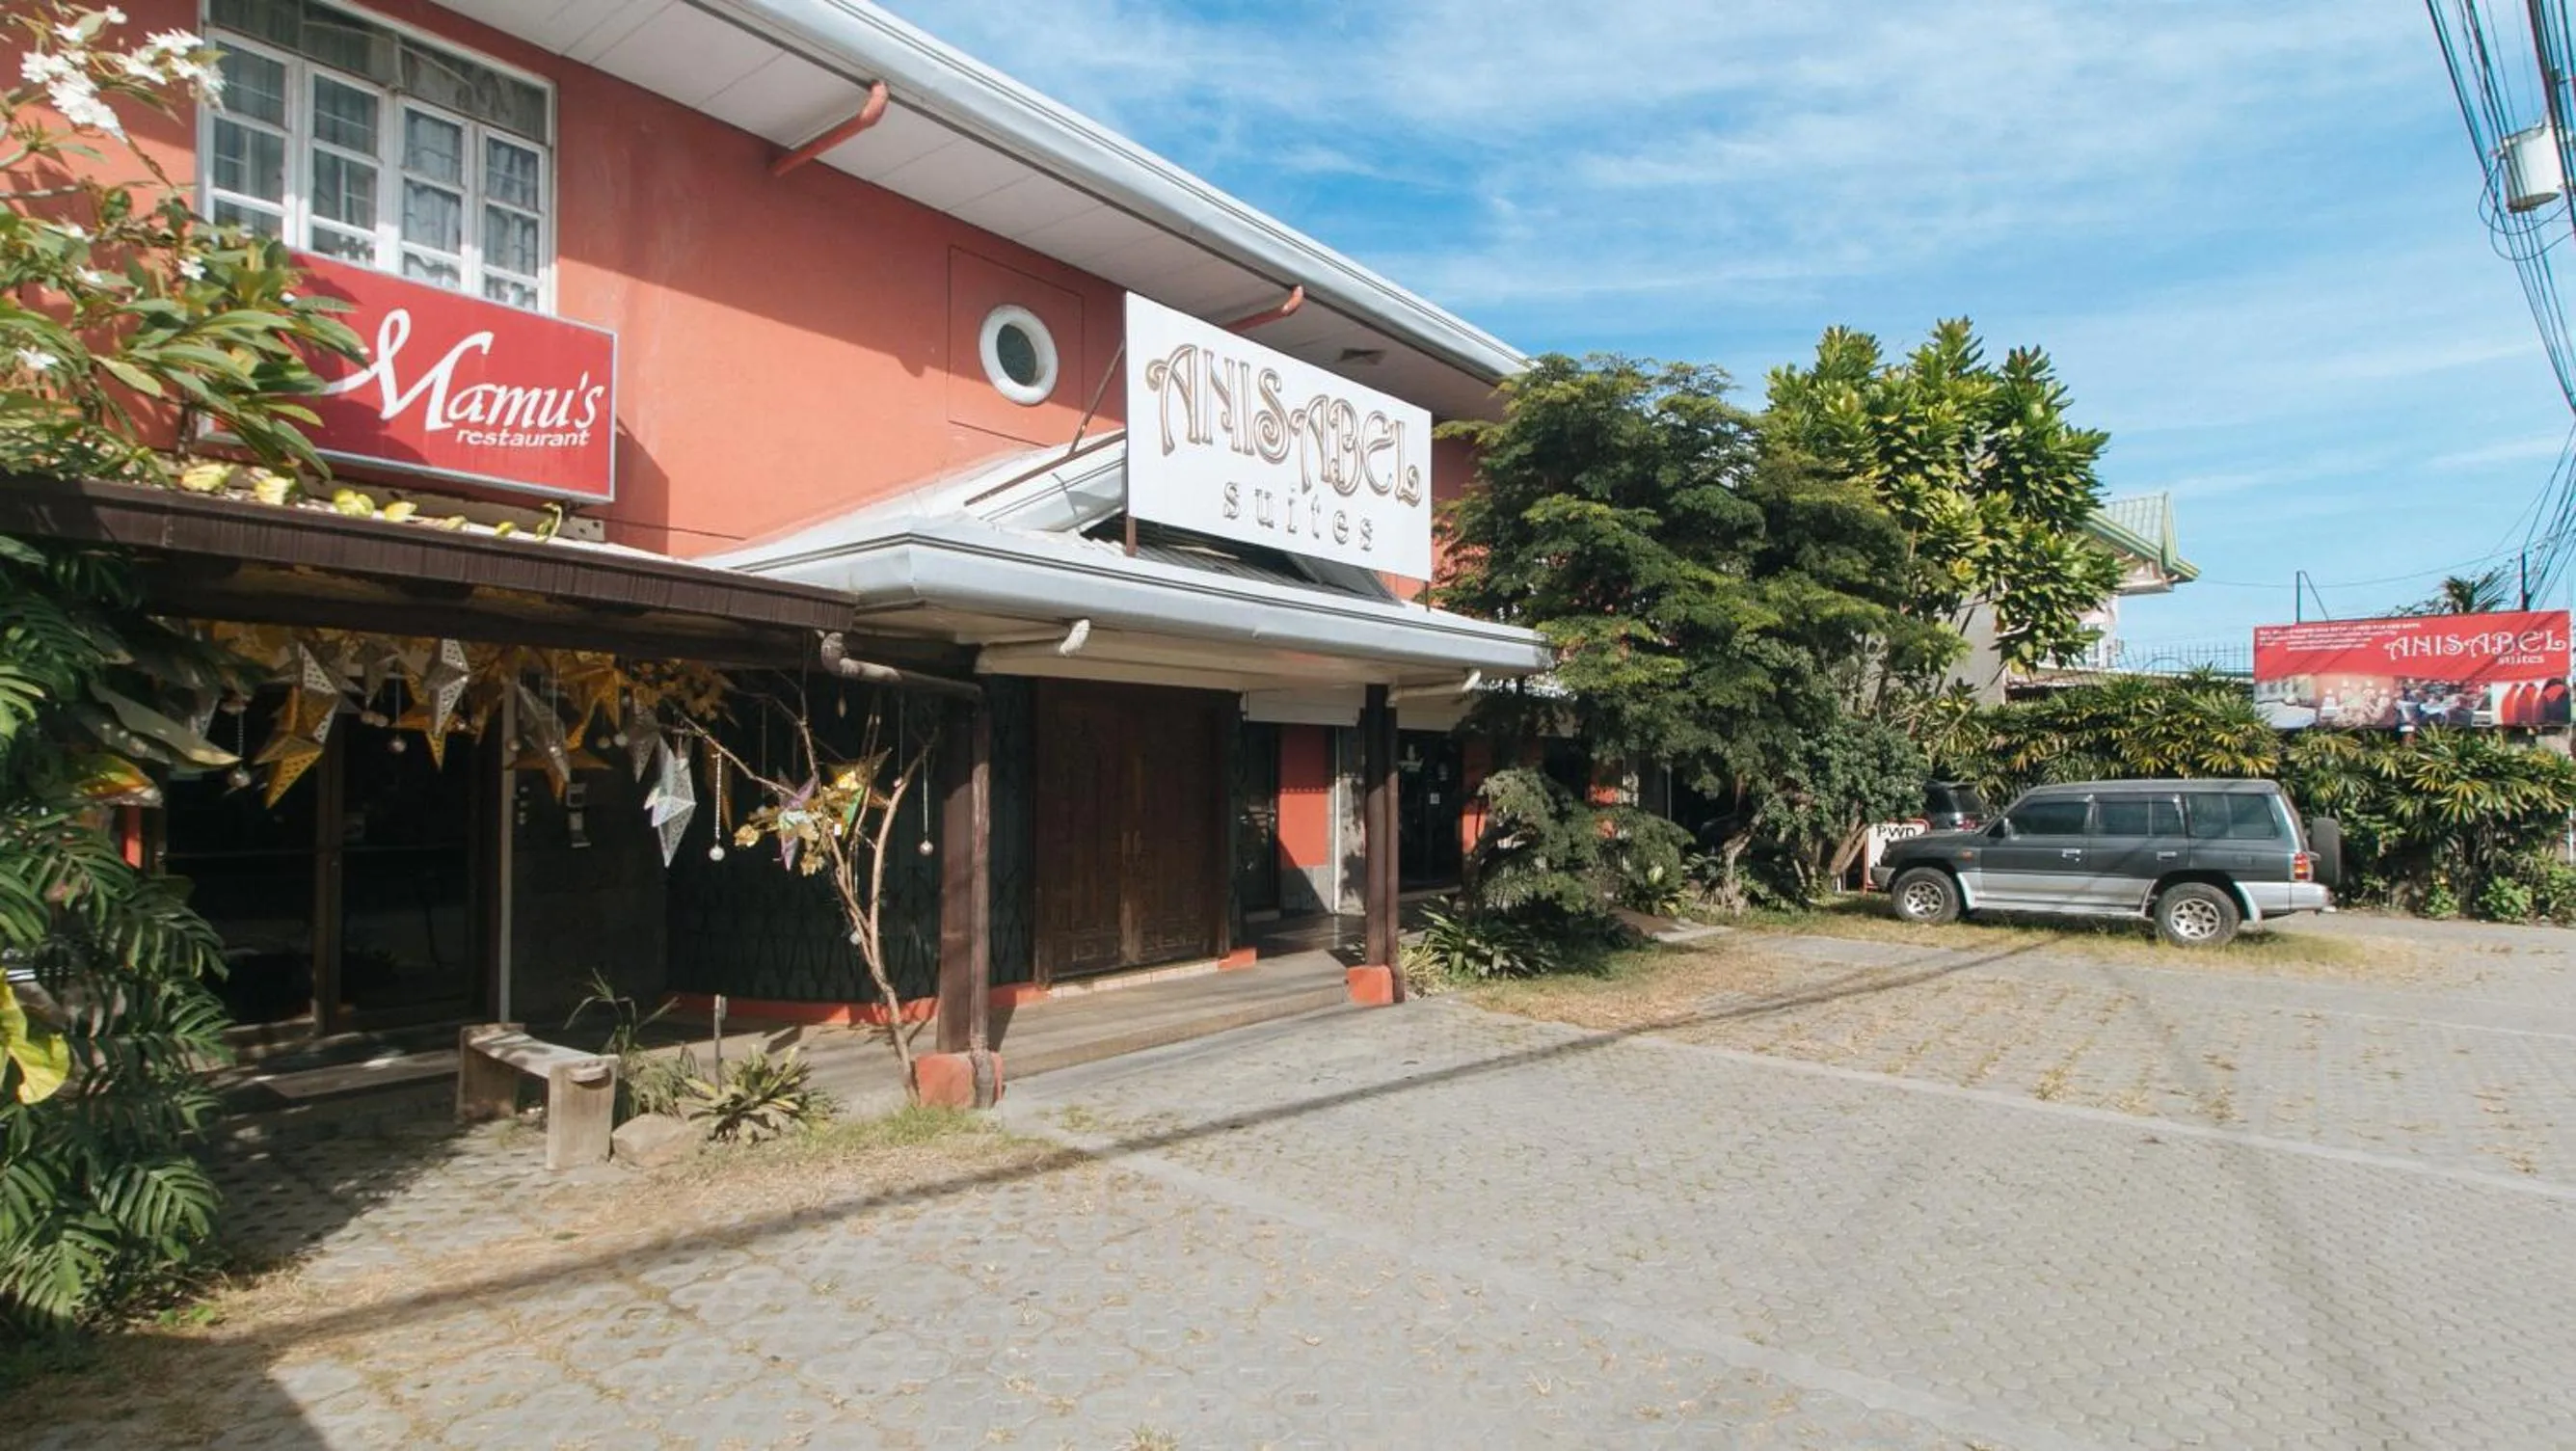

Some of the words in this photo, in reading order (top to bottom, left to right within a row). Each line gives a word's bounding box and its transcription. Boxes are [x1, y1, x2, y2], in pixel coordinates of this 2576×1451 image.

[325, 308, 604, 431] Mamu's
[456, 428, 591, 447] restaurant
[1146, 343, 1422, 507] ANISABEL
[1222, 481, 1373, 551] suites
[2383, 630, 2566, 660] ANISABEL
[2498, 653, 2545, 665] suites
